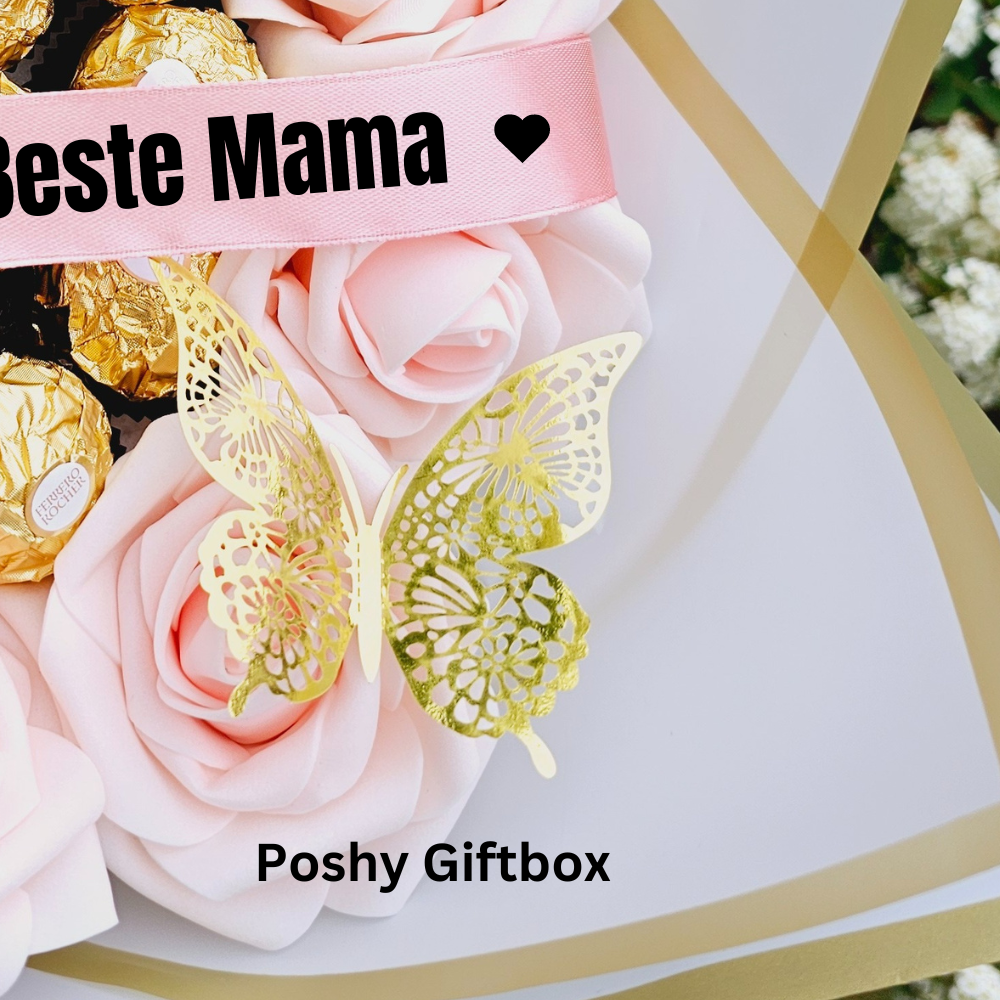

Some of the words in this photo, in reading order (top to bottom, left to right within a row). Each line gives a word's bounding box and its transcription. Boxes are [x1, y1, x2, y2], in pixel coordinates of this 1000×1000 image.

[207, 112, 448, 201] Mama
[35, 467, 80, 517] FERRERO
[41, 476, 87, 526] ROCHER
